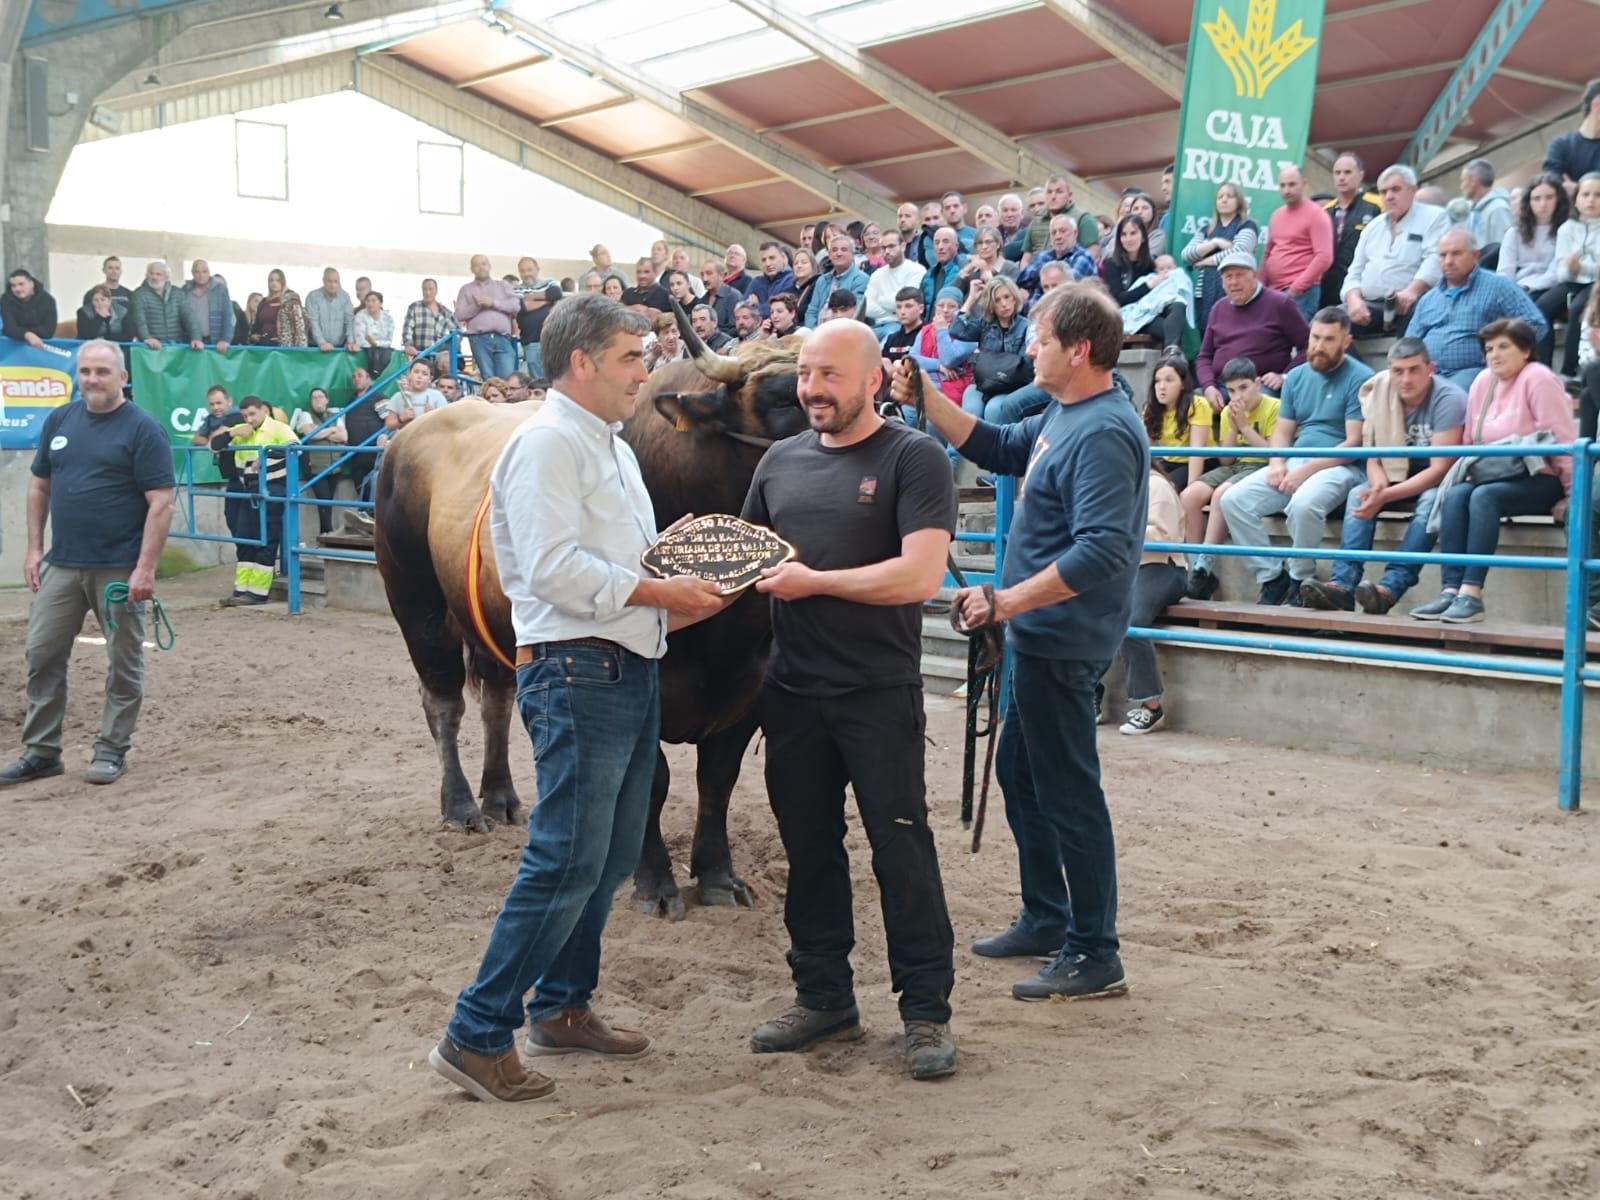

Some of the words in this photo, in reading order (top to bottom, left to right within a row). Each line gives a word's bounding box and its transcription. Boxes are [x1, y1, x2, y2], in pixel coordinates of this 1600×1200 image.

[1205, 109, 1289, 150] CAJA
[666, 519, 715, 545] CONCURSO
[717, 518, 768, 541] NACIONAL
[690, 533, 703, 543] DE
[705, 532, 717, 542] LA
[654, 544, 707, 555] ASTURIANA
[708, 544, 720, 553] DE
[721, 543, 740, 553] LOS
[741, 541, 779, 552] VALLES
